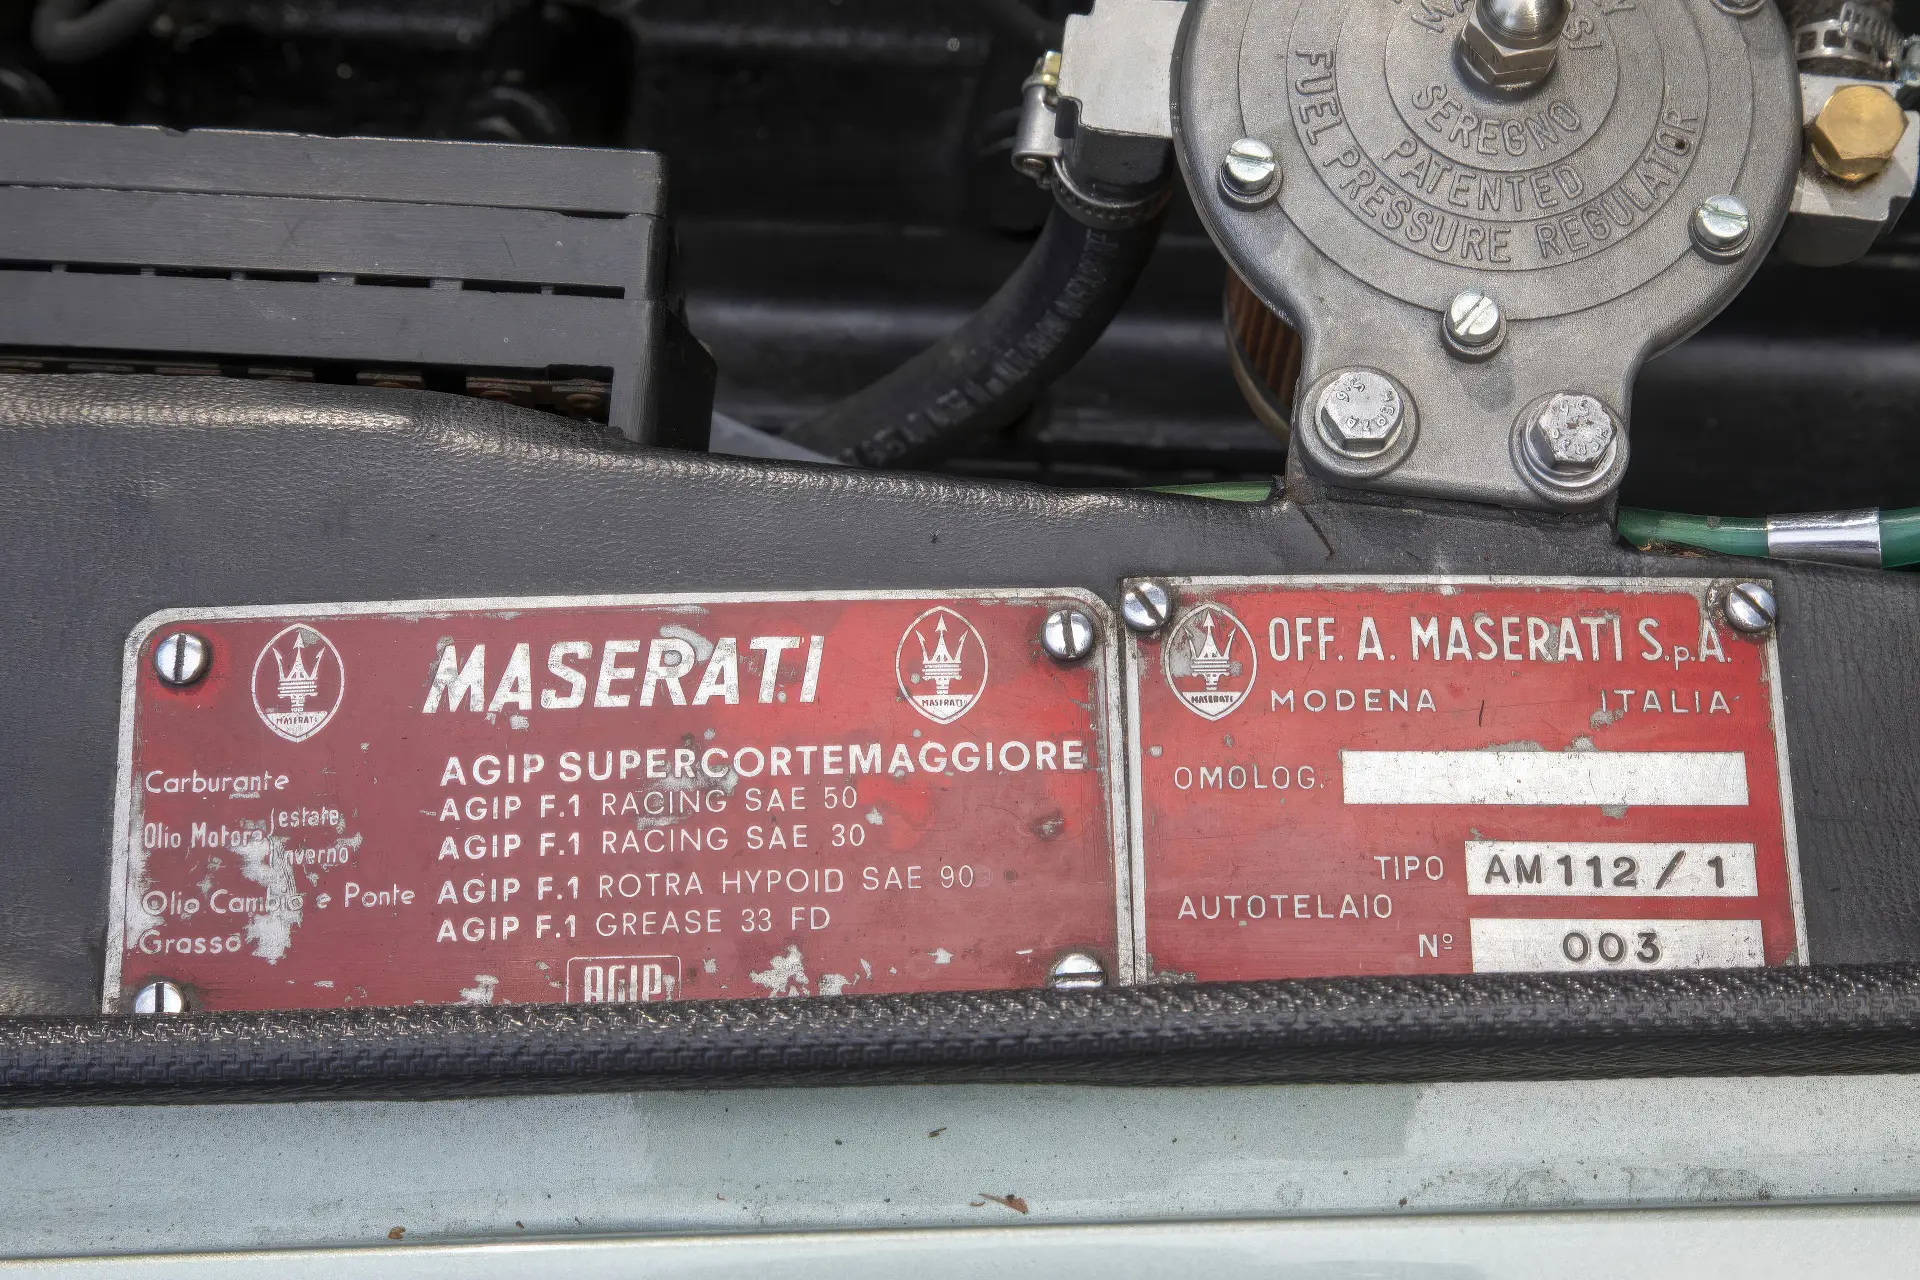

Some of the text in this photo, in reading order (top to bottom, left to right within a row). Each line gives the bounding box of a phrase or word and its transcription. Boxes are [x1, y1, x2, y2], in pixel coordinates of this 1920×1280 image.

[1411, 83, 1581, 157] SEREGNO
[1294, 49, 1699, 263] FUEL PRESSURE REGULATOR
[1382, 136, 1585, 212] PATENTED
[1268, 615, 1733, 671] OFF. A. MASERATI S.p.A.
[422, 634, 825, 714] MASERATI
[921, 698, 964, 708] MASERATI
[1190, 694, 1234, 704] MASERATI
[1270, 688, 1437, 713] MODENA
[1600, 689, 1732, 714] ITALIA
[439, 740, 1084, 787] AGIP SUPERCORTEMAGGIORE
[1173, 765, 1325, 790] OMOLOG.
[145, 770, 290, 794] Carburante
[278, 806, 339, 828] estate
[438, 785, 858, 821] AGIP F.1 RACING SAE 50
[143, 821, 181, 849] Olio
[437, 823, 866, 860] AGIP F.1 RACING SAE 30
[278, 847, 349, 864] nverno
[1373, 855, 1445, 881] TIPO
[142, 882, 416, 916] Olio Cambio e Ponte
[436, 864, 974, 904] AGIP F.1 ROTRA HYPOID SAE 90
[1177, 893, 1393, 920] AUTOTELAIO
[436, 906, 831, 943] AGIP F.1 GREASE 33 FD
[138, 928, 242, 955] Grasso
[1562, 931, 1664, 964] 003
[583, 963, 662, 1002] AGIP
